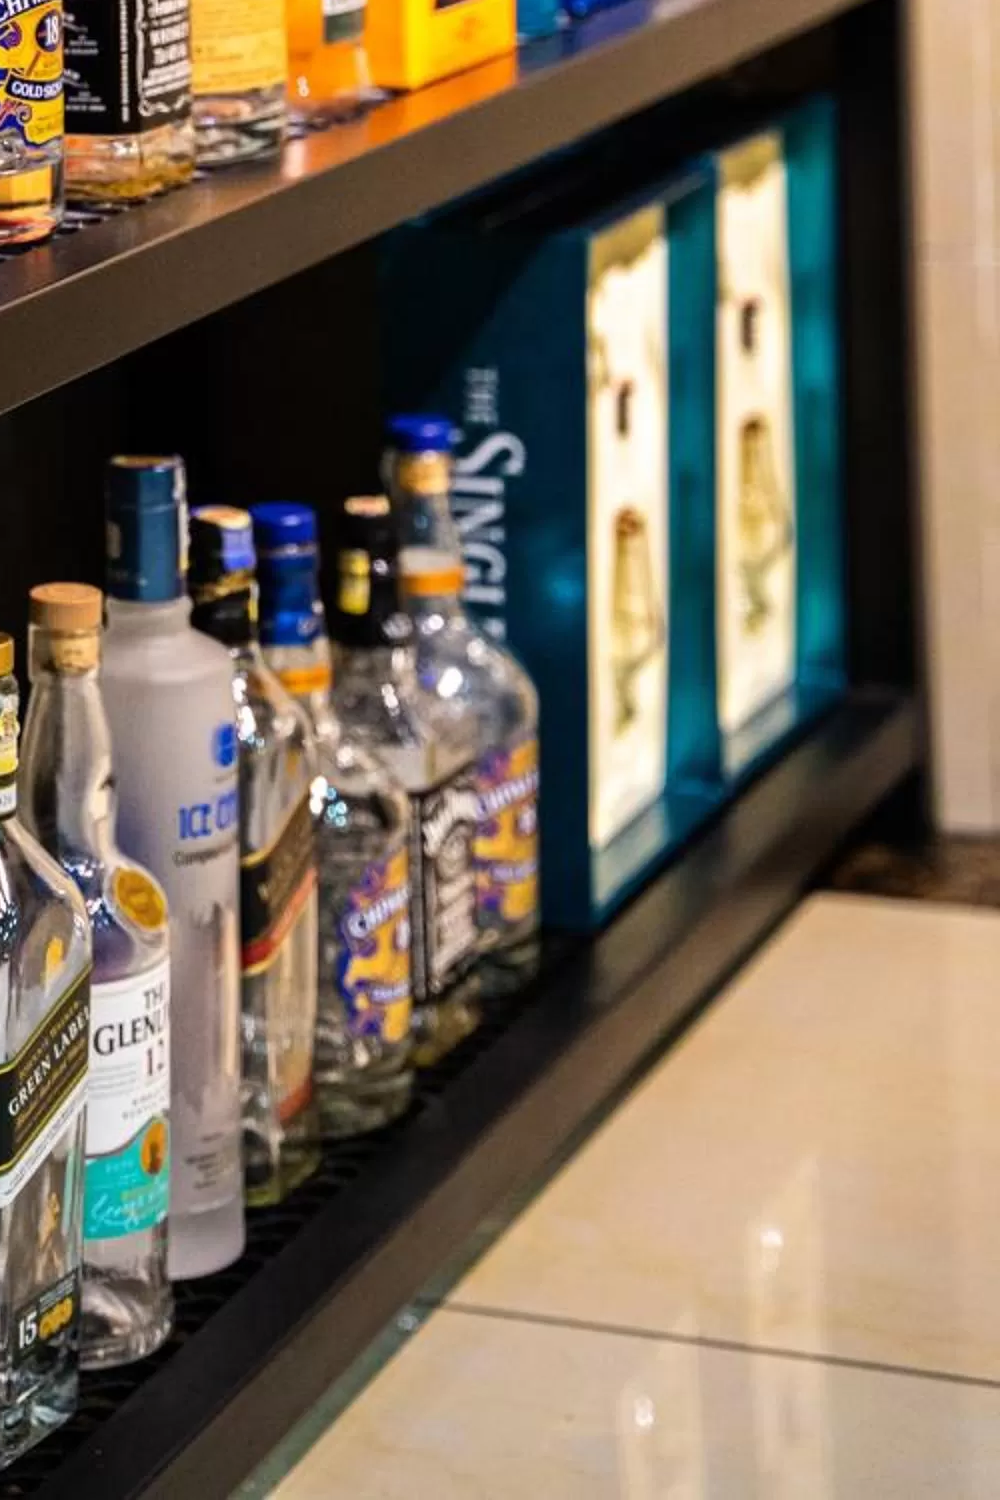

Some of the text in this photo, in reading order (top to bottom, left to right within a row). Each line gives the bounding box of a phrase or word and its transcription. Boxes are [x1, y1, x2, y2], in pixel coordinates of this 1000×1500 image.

[44, 14, 59, 47] 18
[8, 1054, 52, 1117] GREEN
[18, 1310, 38, 1350] 15
